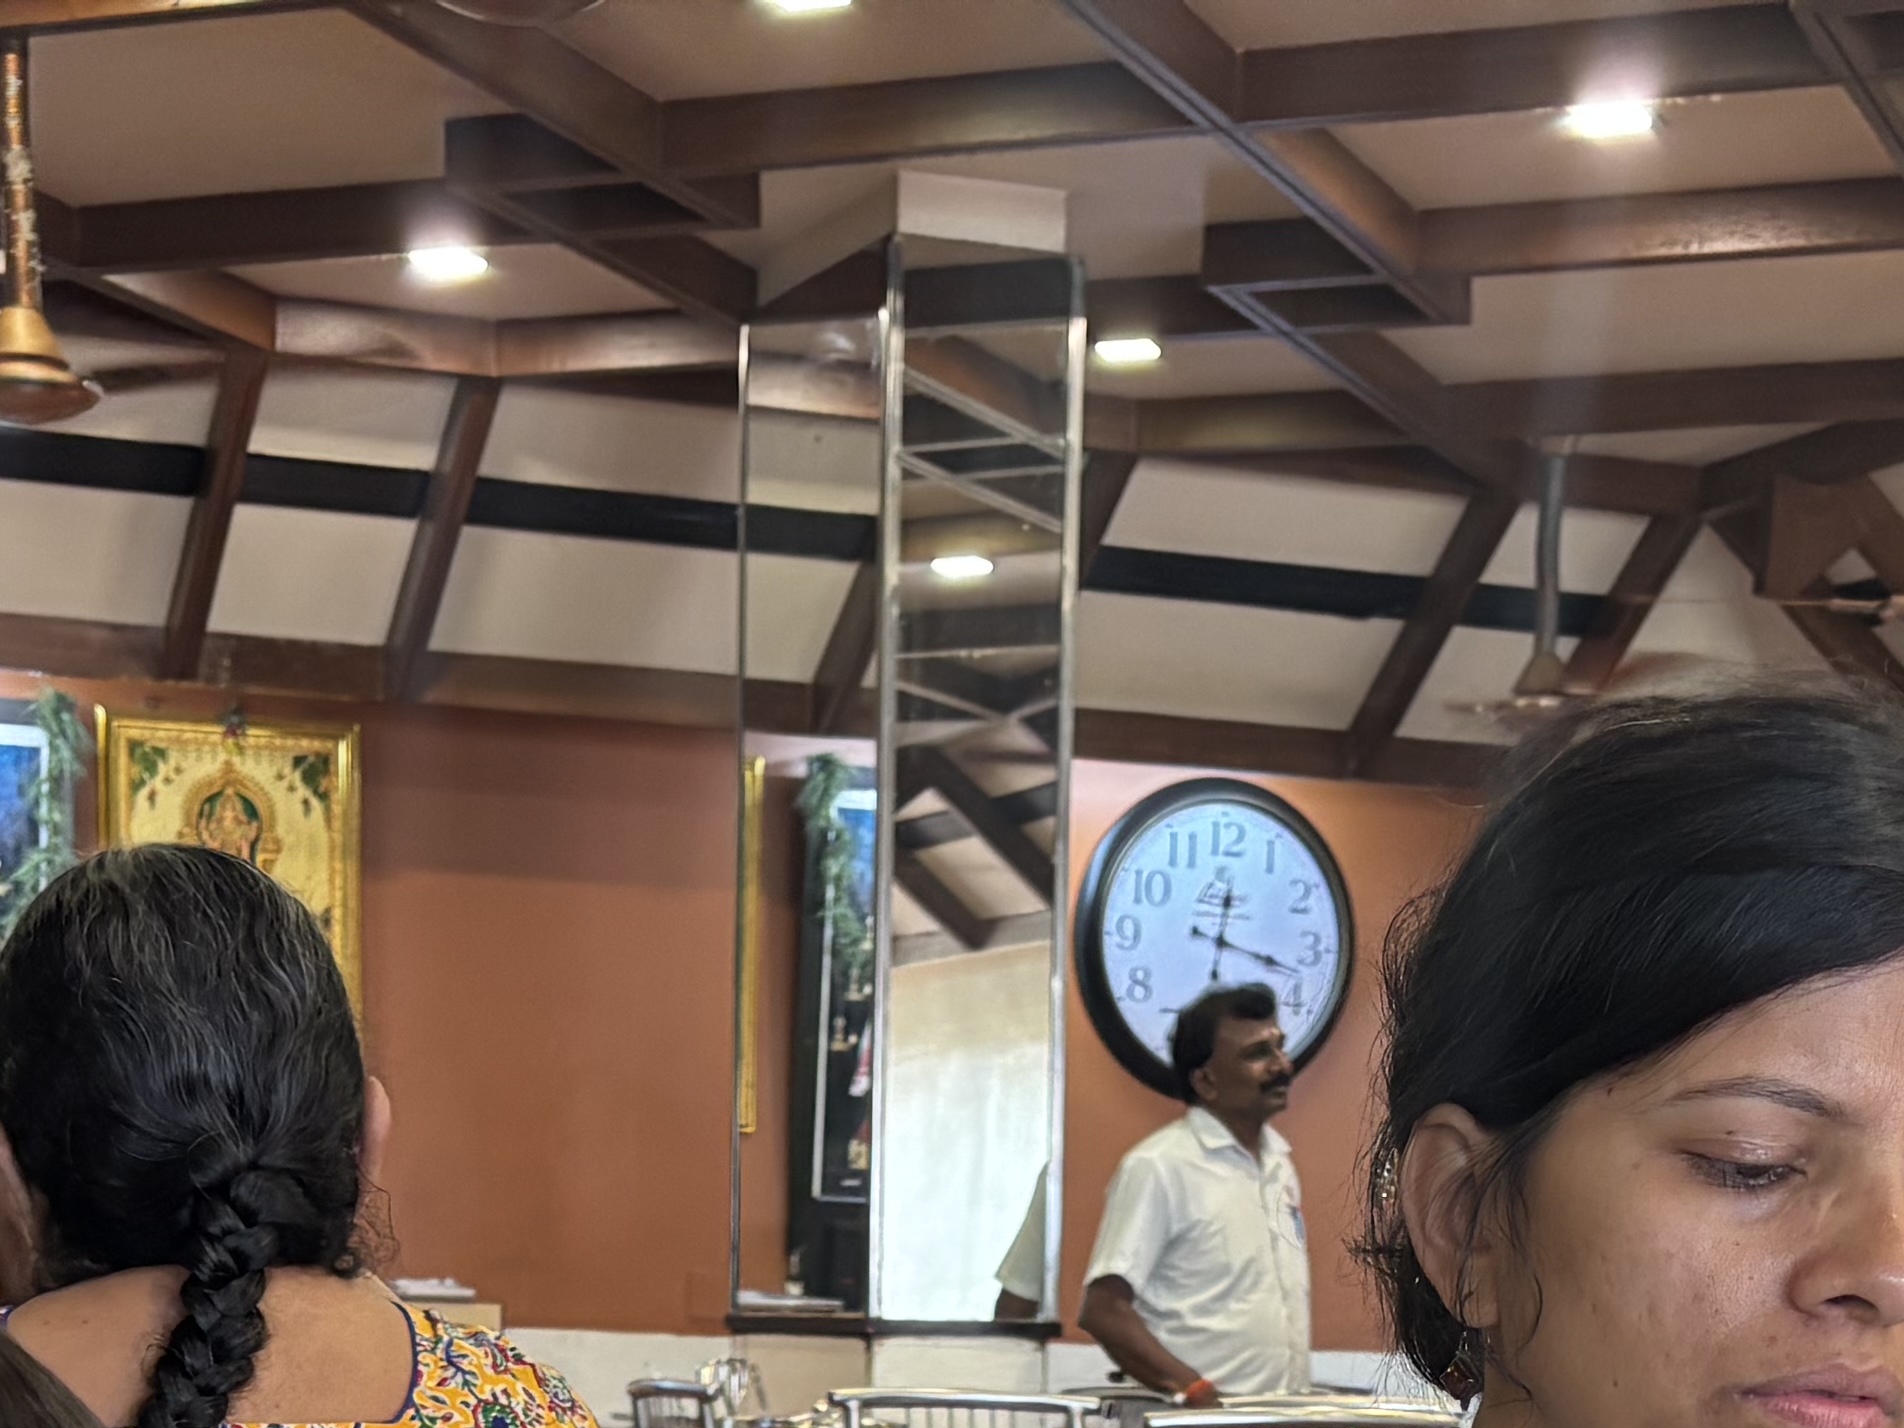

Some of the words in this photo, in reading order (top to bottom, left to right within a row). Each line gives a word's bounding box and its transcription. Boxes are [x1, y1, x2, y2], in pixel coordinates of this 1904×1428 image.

[1169, 831, 1197, 868] 11
[1210, 820, 1247, 858] 12
[1264, 840, 1275, 875] 1
[1133, 868, 1173, 907] 10
[1288, 879, 1313, 915] 2
[1114, 914, 1143, 952] 9
[1296, 930, 1322, 967] 3
[1126, 967, 1152, 1003] 8
[1282, 977, 1308, 1017] 4
